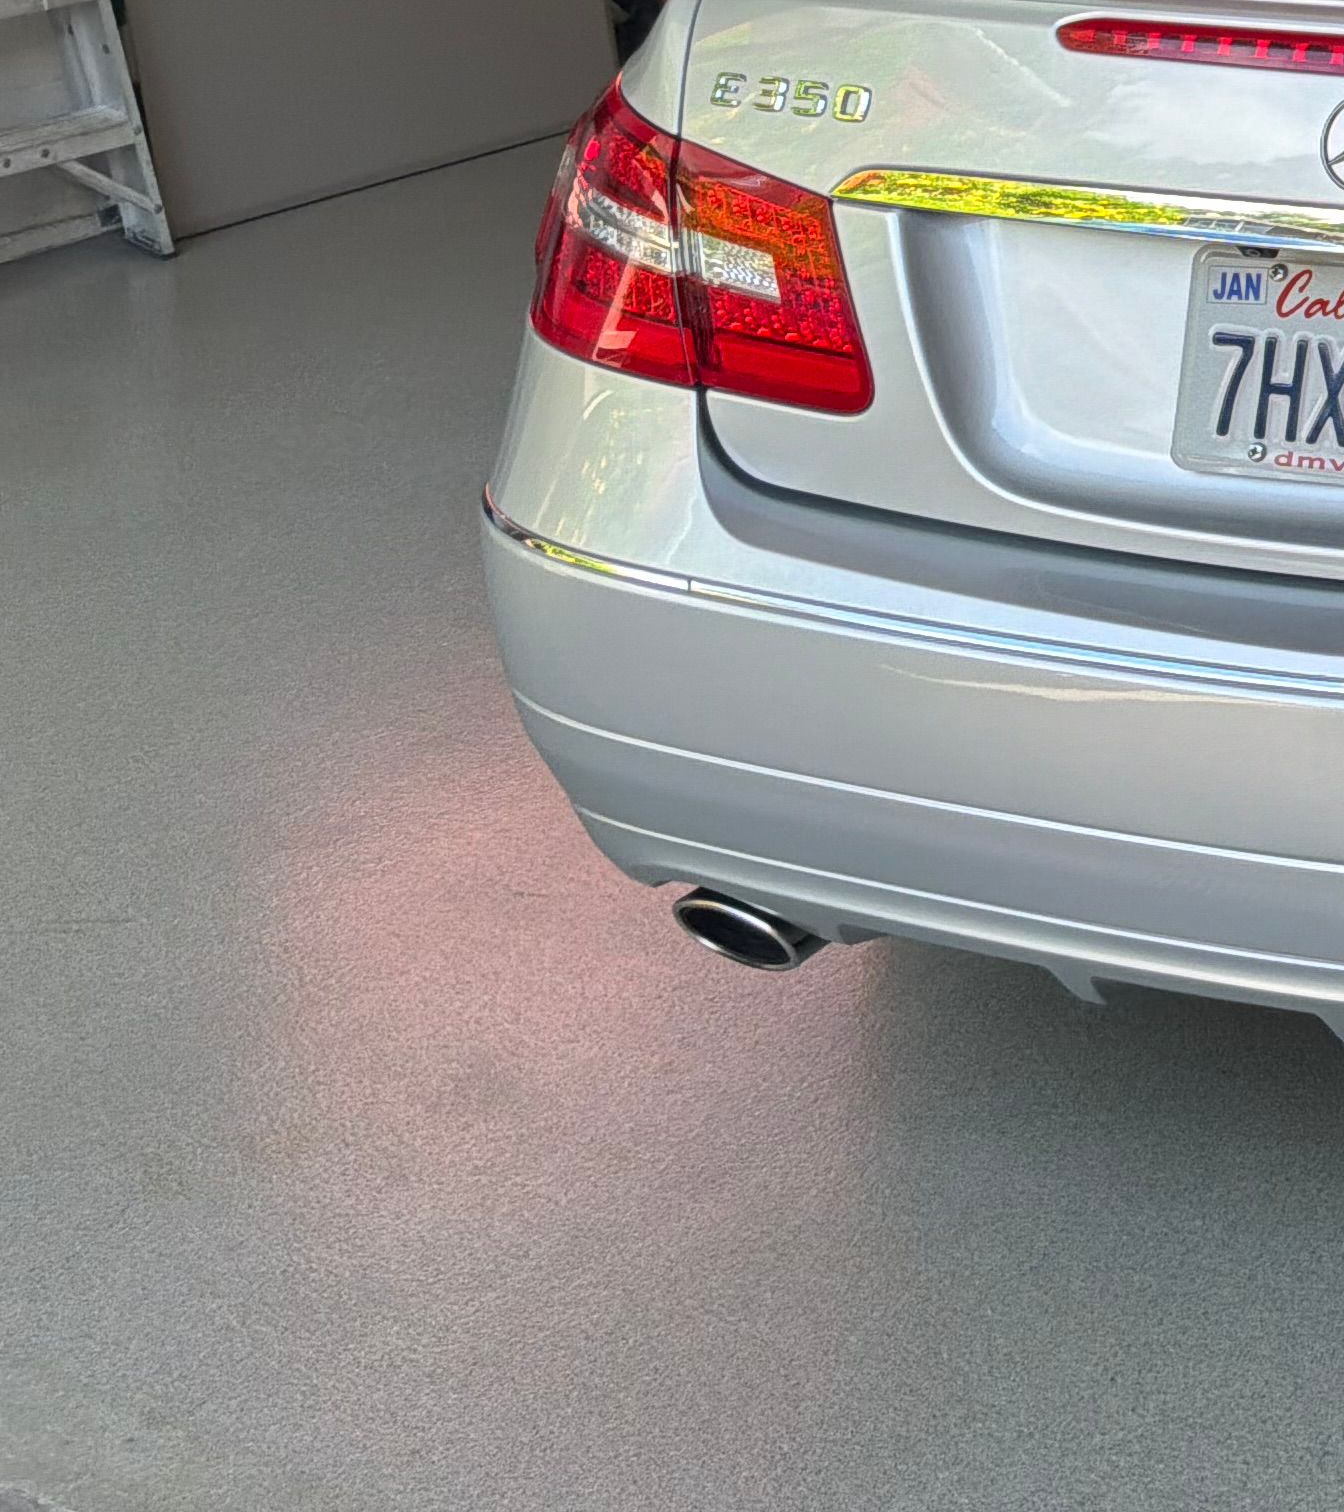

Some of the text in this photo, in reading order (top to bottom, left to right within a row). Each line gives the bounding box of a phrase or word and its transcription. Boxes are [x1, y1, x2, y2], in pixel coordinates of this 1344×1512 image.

[709, 71, 873, 123] E 350
[1212, 271, 1263, 303] JAN
